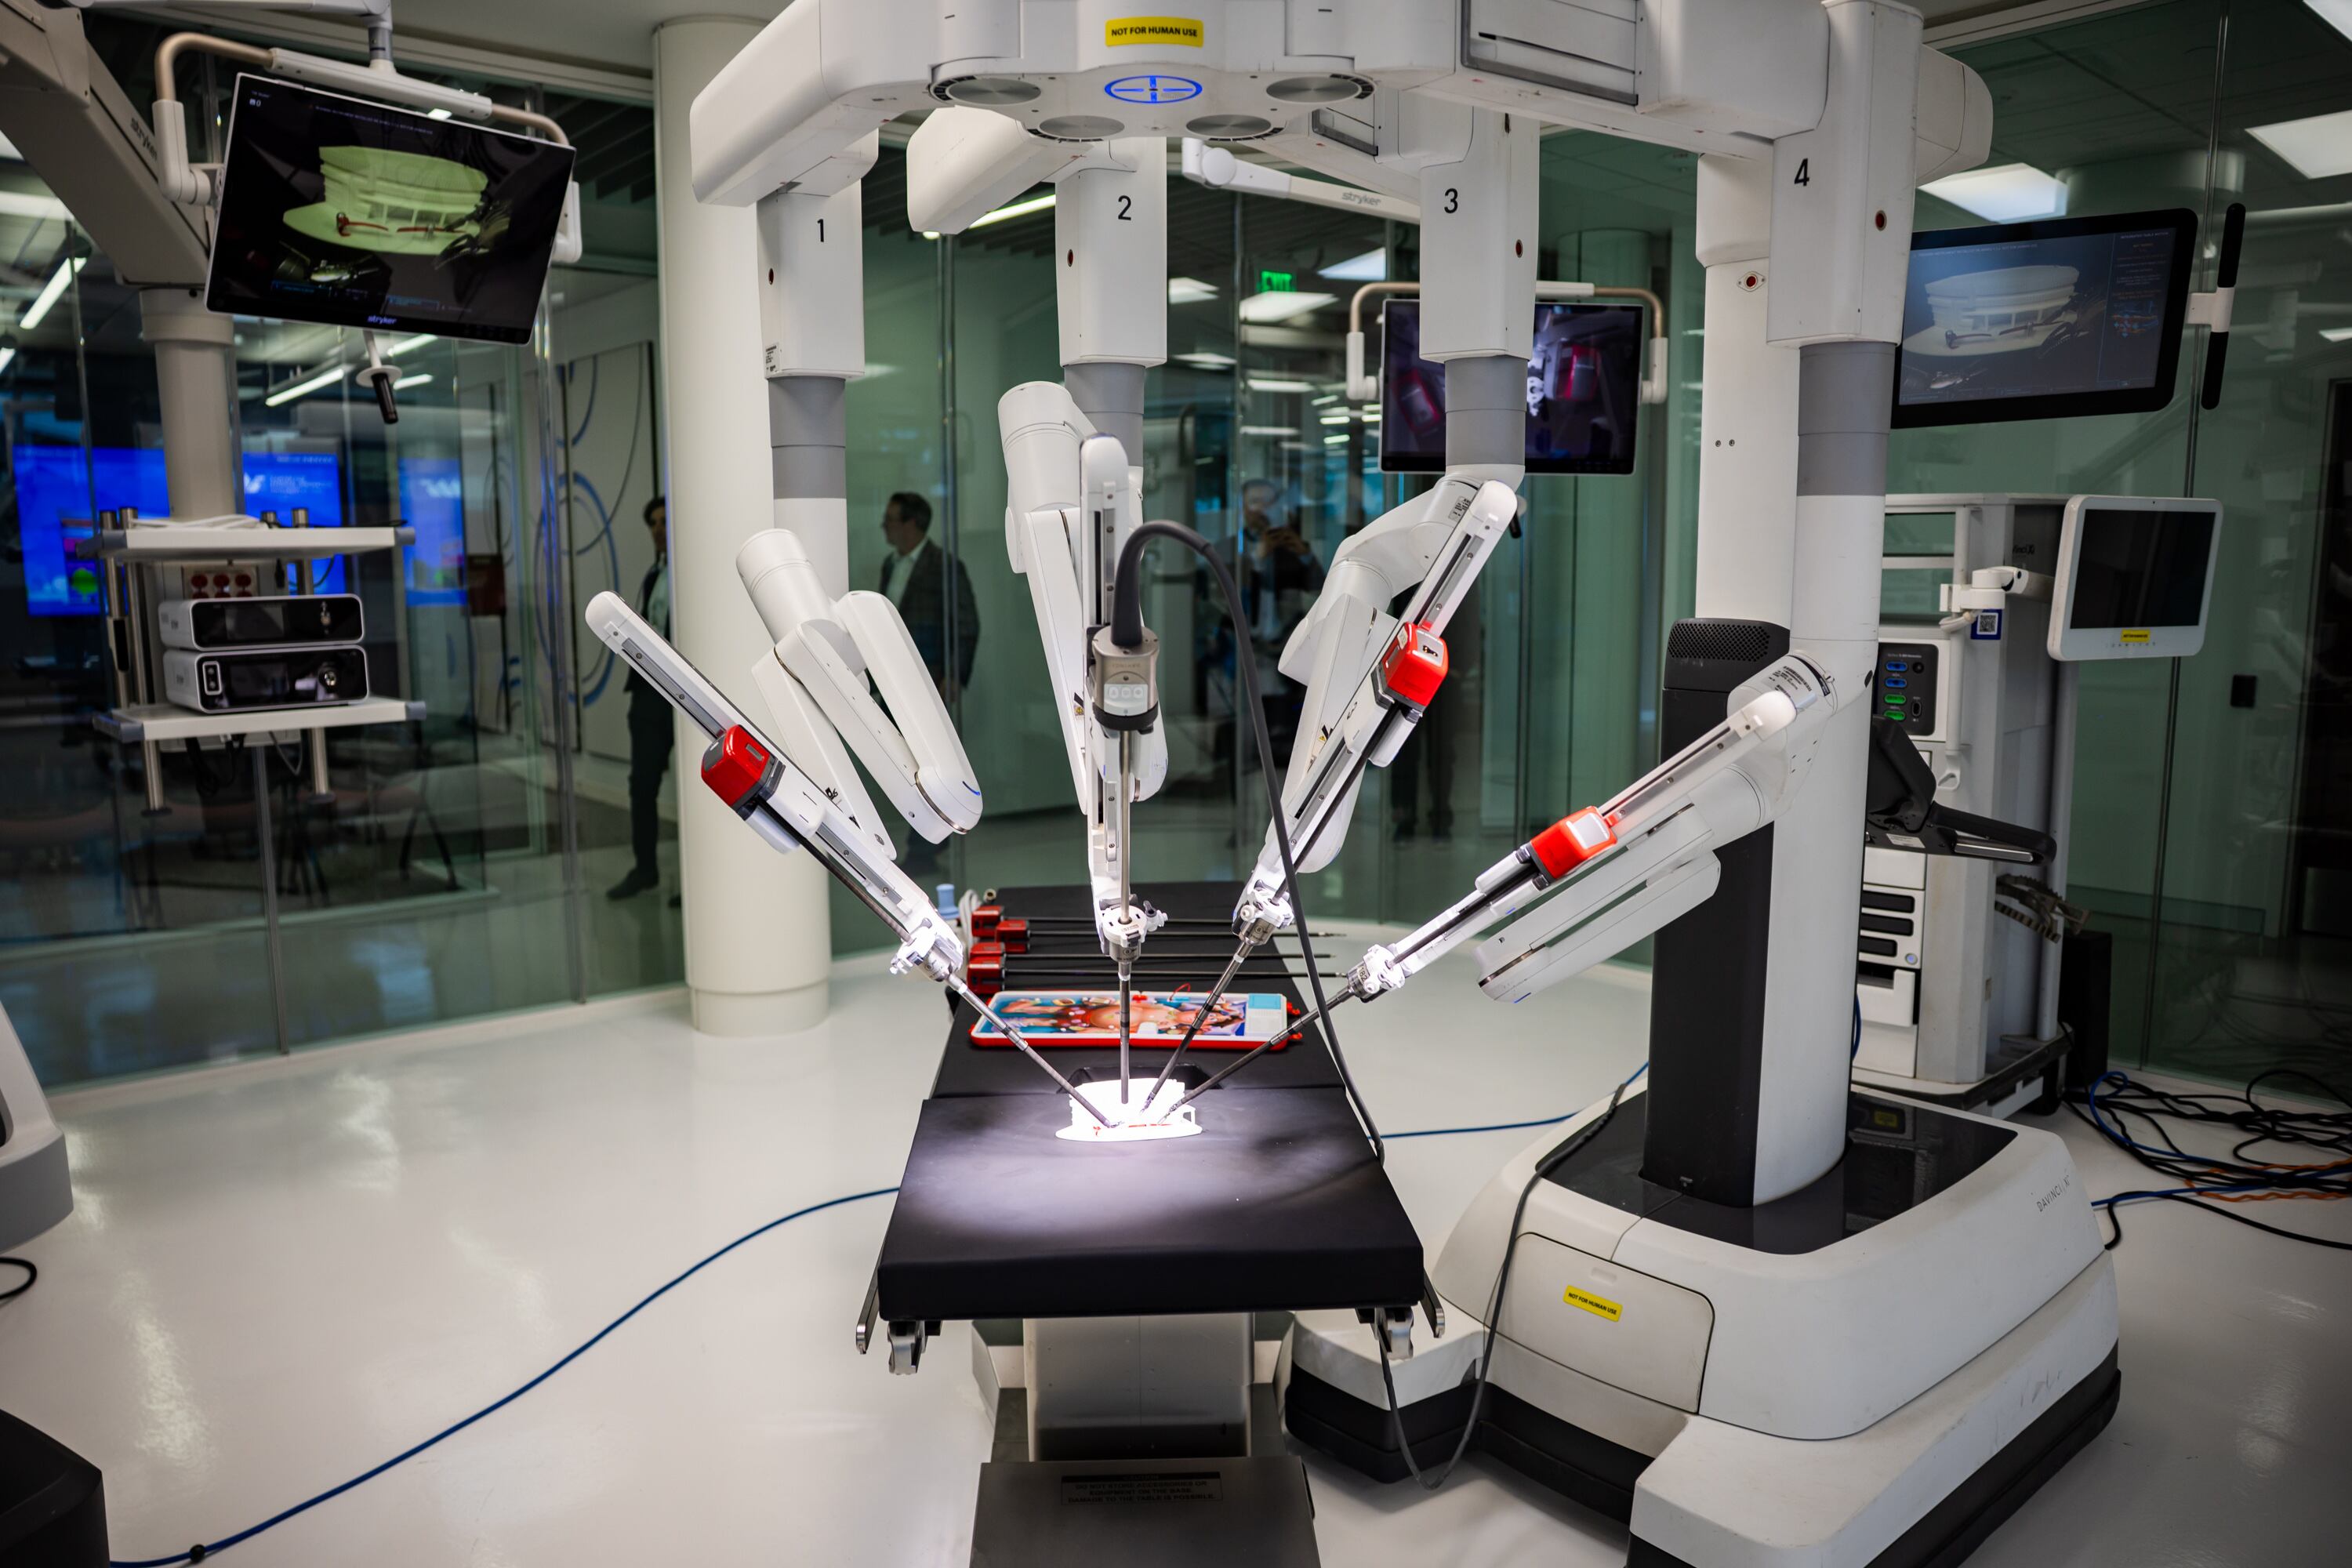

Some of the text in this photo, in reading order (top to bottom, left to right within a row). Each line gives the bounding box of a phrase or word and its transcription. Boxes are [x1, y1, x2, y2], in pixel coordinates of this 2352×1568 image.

[1111, 27, 1128, 36] NOT
[1148, 27, 1181, 35] HUMAN
[1182, 28, 1197, 37] USE
[1794, 158, 1809, 187] 4
[1118, 194, 1131, 221] 2
[1341, 192, 1381, 205] stryker
[1444, 187, 1458, 214] 3
[817, 219, 824, 243] 1
[367, 314, 397, 325] stryker
[2036, 1184, 2063, 1212] DAVINCI
[1588, 1300, 1606, 1311] HUMAN
